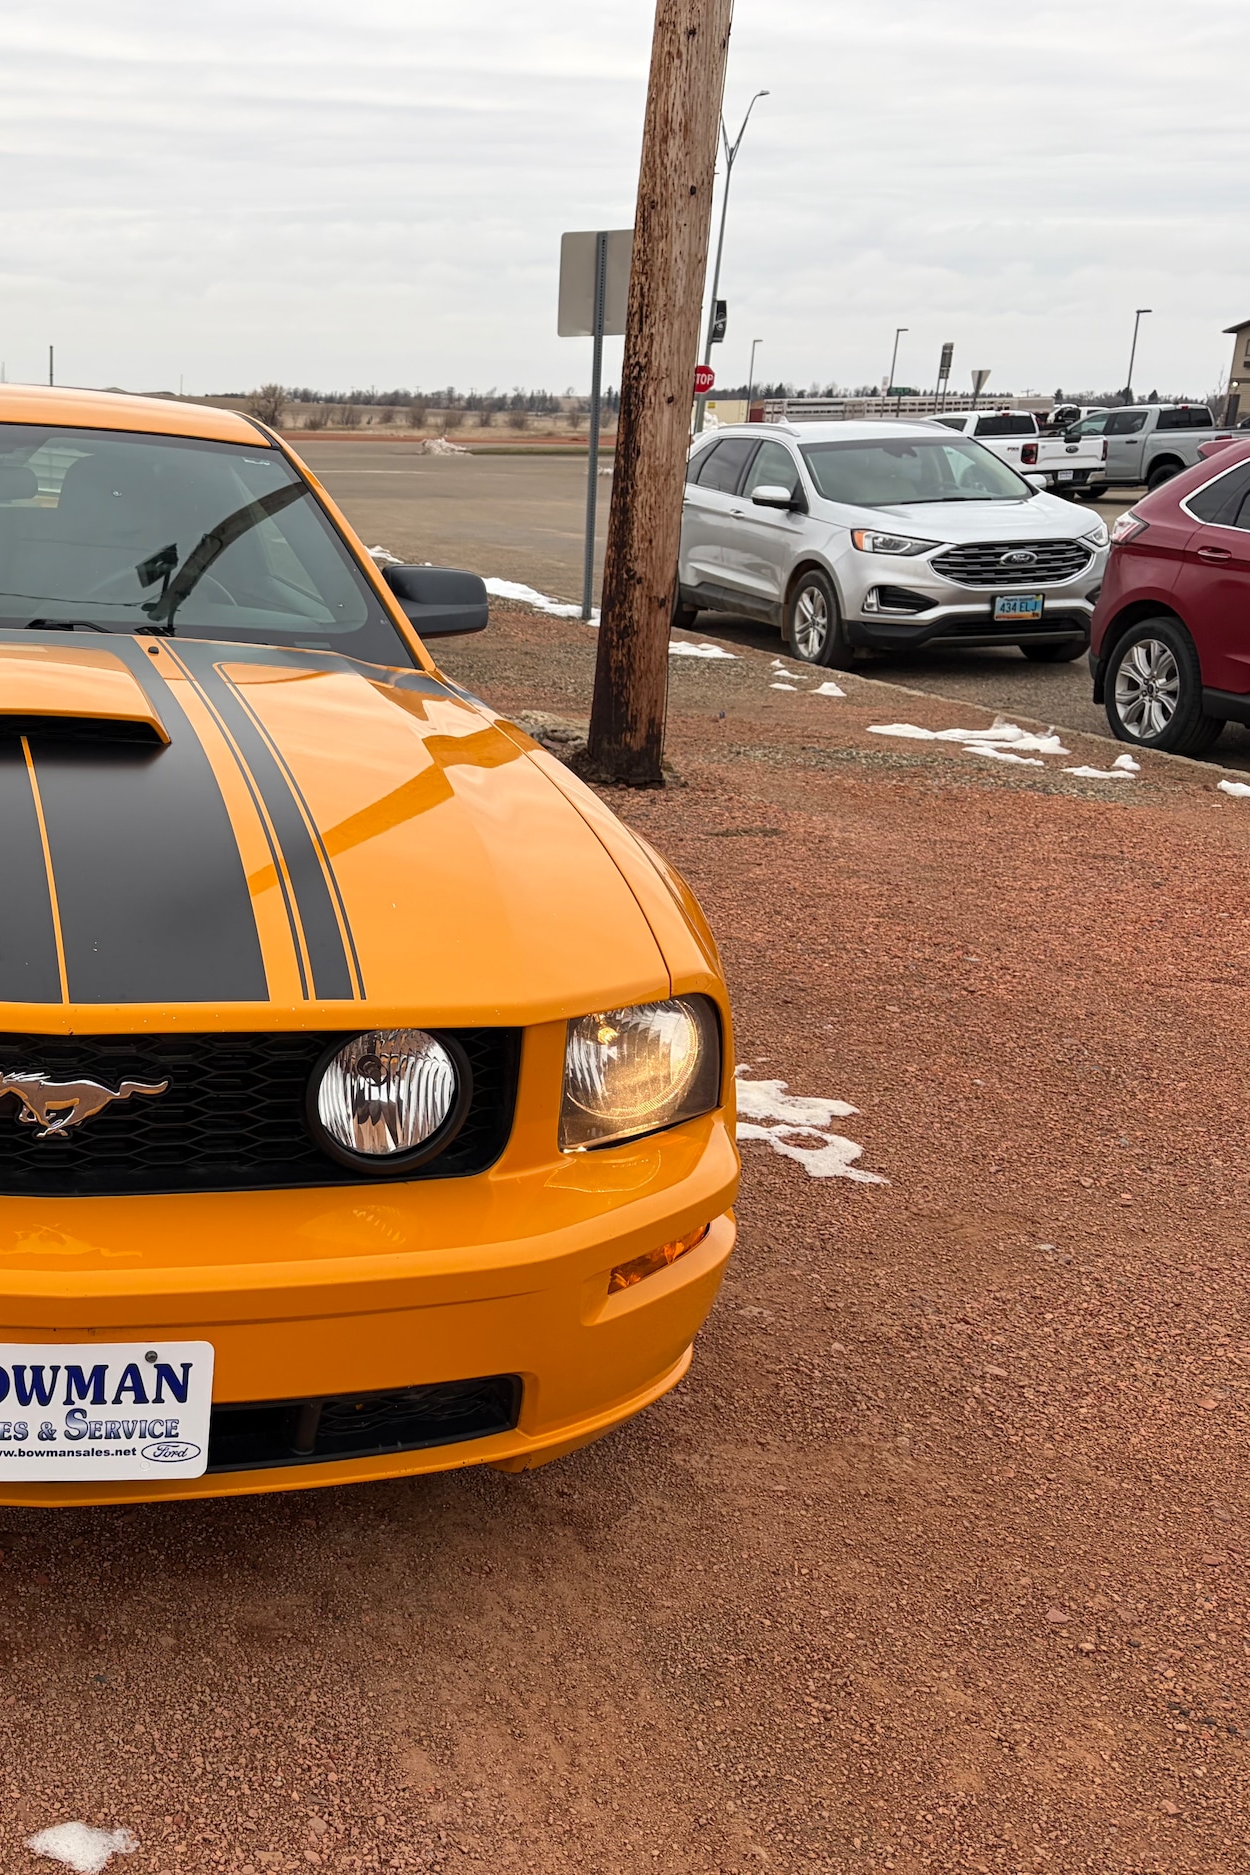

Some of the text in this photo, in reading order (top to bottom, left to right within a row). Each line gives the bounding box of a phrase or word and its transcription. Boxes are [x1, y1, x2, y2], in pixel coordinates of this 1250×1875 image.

[696, 373, 714, 385] TOP
[999, 601, 1038, 614] 434 ELJ
[37, 1421, 57, 1441] &
[63, 1407, 180, 1441] SERVICE
[152, 1444, 188, 1459] Ford
